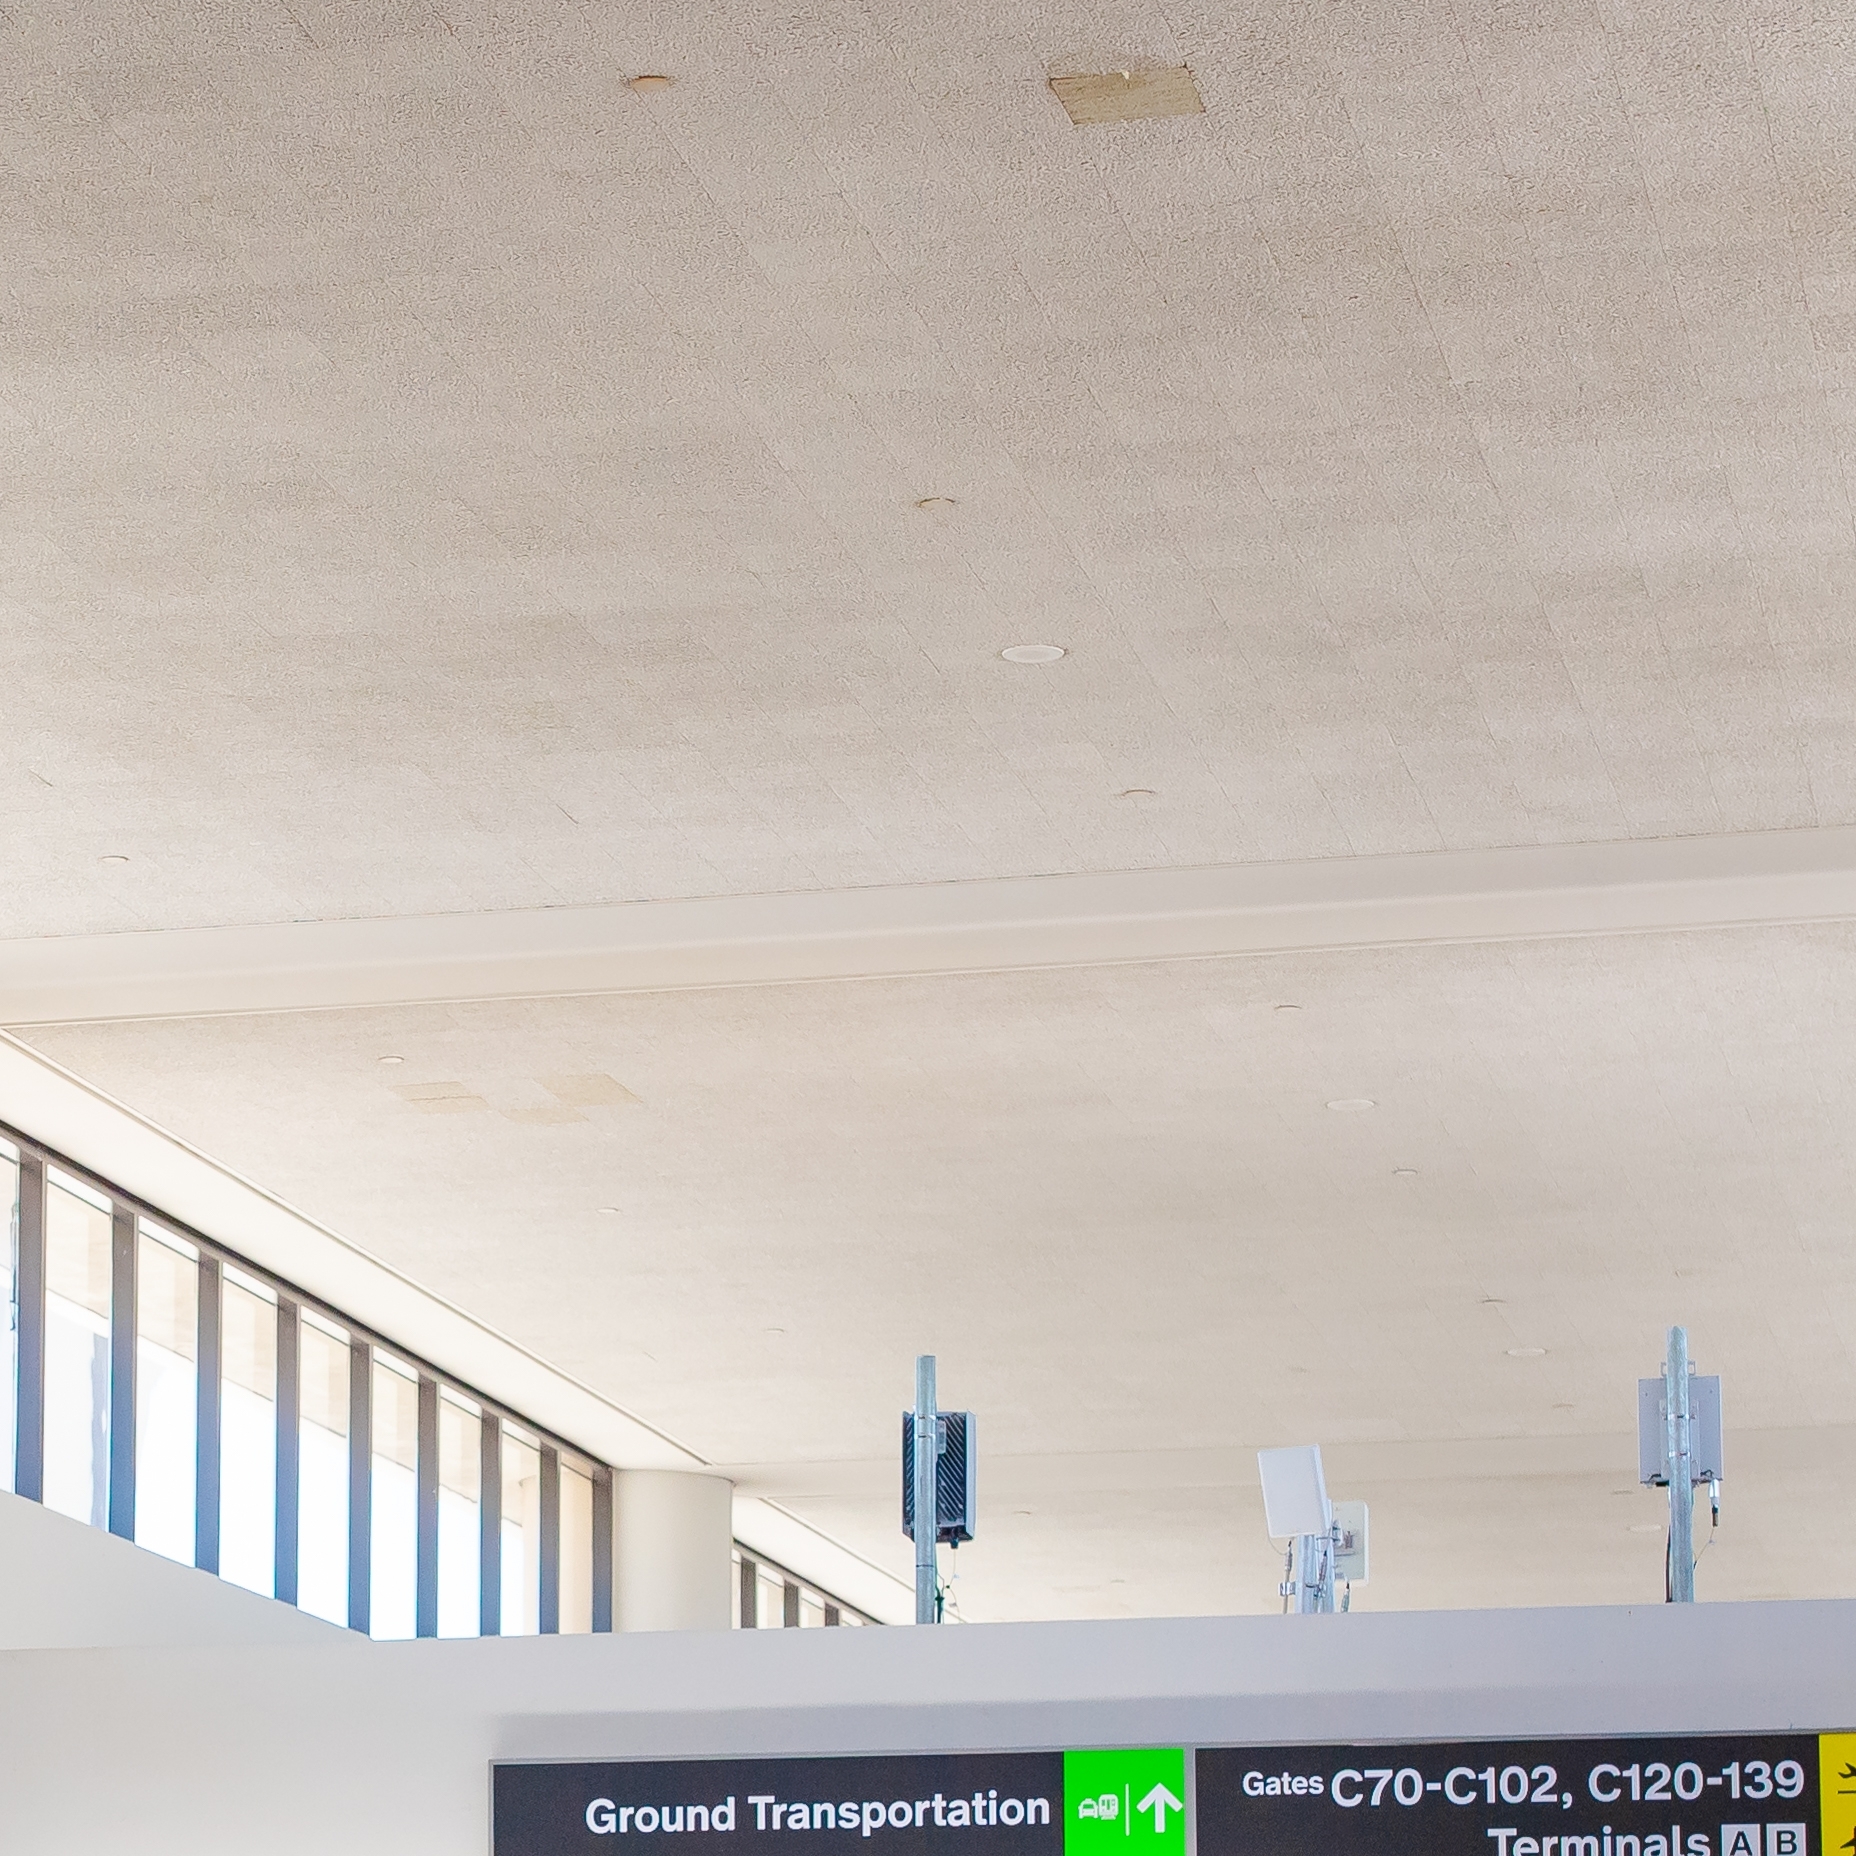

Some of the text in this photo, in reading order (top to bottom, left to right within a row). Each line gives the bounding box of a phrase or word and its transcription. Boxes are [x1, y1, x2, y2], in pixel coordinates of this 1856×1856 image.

[1242, 1760, 1804, 1810] Gates C70-C102, C120-139
[586, 1792, 1050, 1838] Ground Transportation
[1775, 1829, 1799, 1856] B
